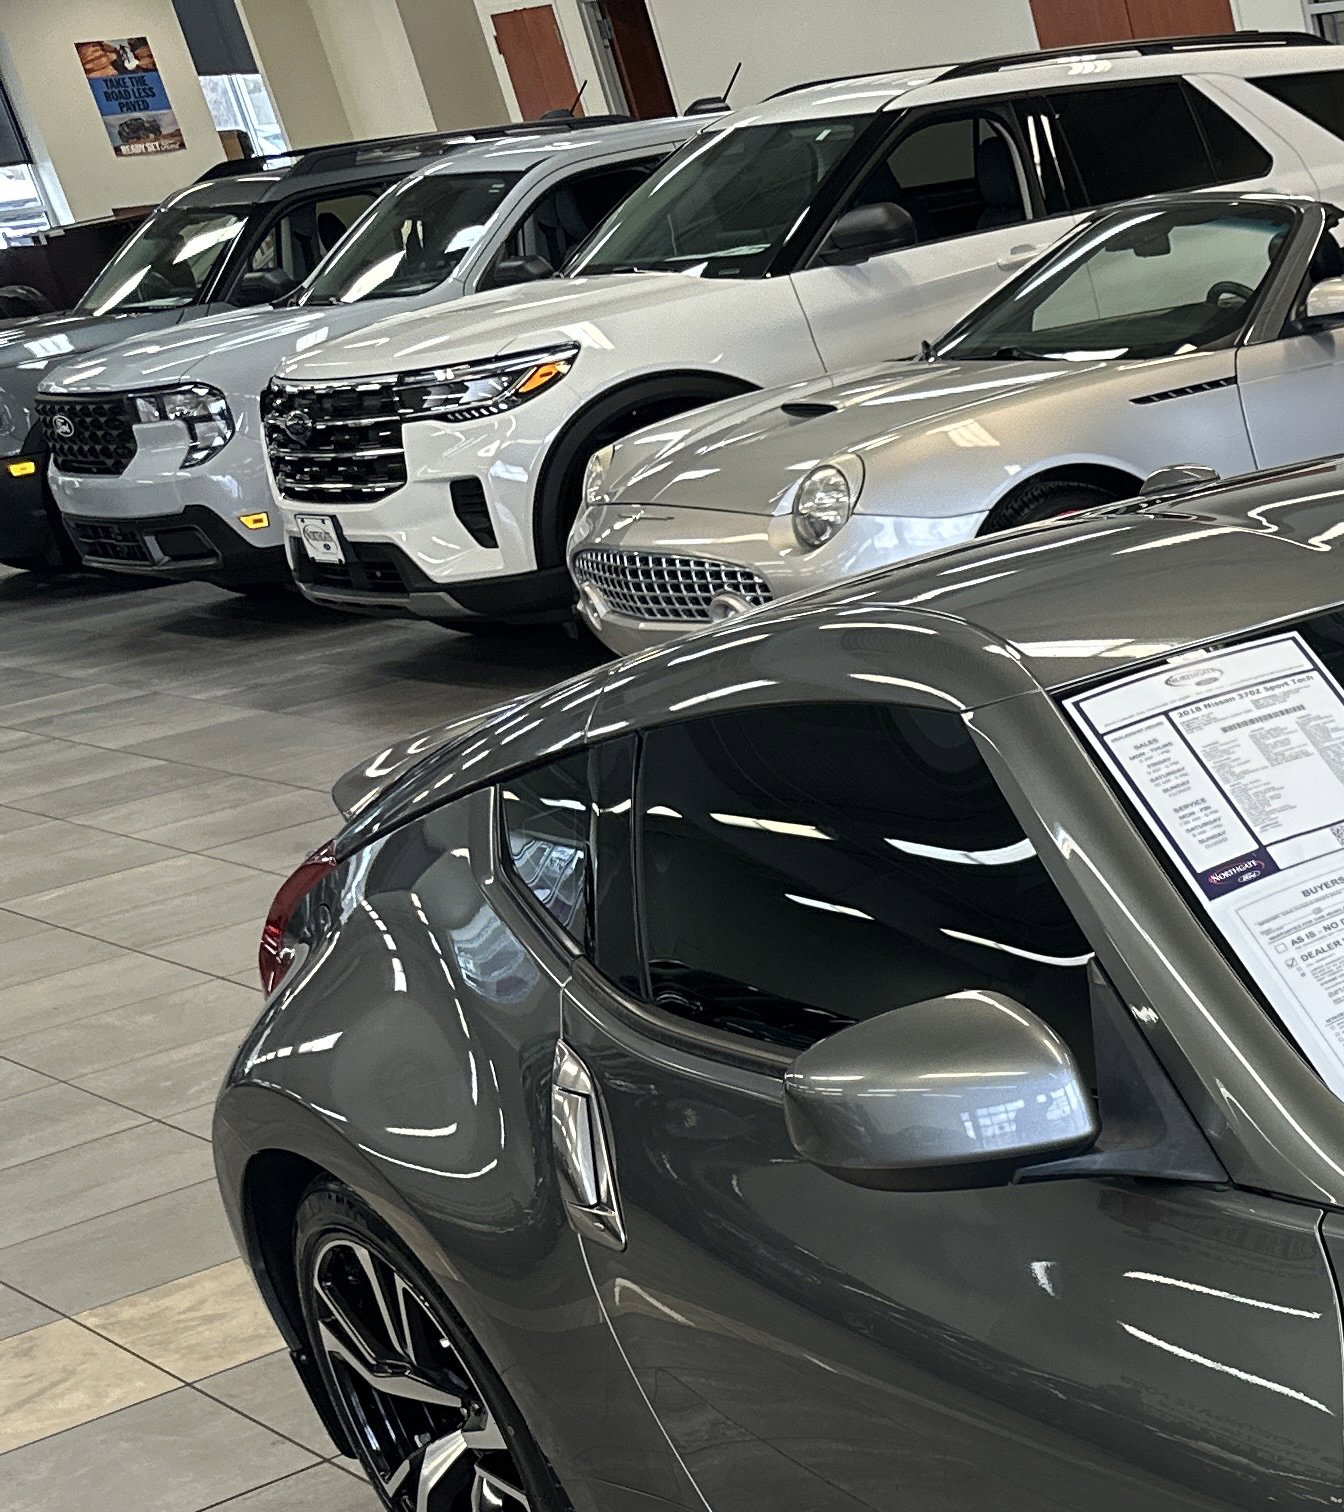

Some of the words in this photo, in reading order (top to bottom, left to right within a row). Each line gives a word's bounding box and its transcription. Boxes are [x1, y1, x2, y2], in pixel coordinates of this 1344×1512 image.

[103, 79, 127, 90] TAKE
[128, 75, 149, 88] THE
[104, 90, 131, 102] ROAD
[131, 87, 156, 99] LESS
[118, 100, 149, 113] PAVED
[1176, 706, 1203, 719] 2018
[1203, 695, 1236, 710] Nissan
[1263, 681, 1290, 693] Sport
[1291, 675, 1314, 685] Tech
[1133, 738, 1159, 750] SALES
[1150, 766, 1185, 783] SATURDAY
[1173, 798, 1206, 813] SERVICE
[1185, 816, 1222, 834] SATURDAY
[1209, 859, 1258, 882] NORTHGATE
[1290, 935, 1305, 947] AS
[1305, 929, 1317, 941] IS
[1322, 920, 1340, 933] NO
[1299, 940, 1343, 963] DEALER
